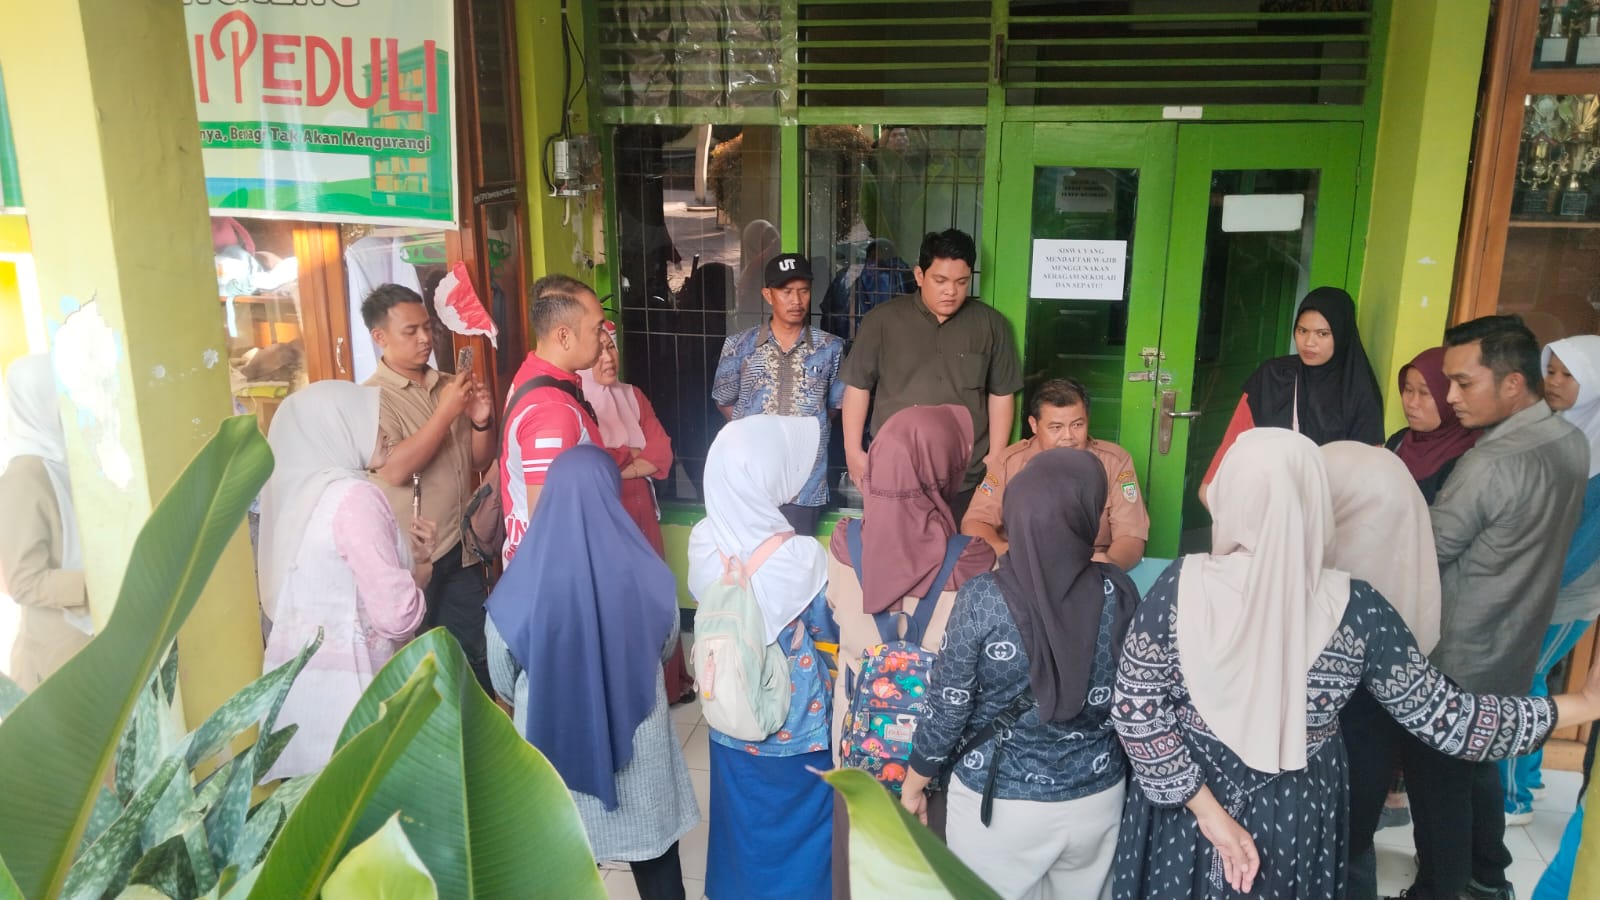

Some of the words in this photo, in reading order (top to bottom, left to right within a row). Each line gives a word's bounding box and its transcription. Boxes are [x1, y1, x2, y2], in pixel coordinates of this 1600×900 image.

[209, 9, 438, 114] PEDULI
[270, 127, 298, 143] Tak
[303, 129, 339, 146] Akan
[342, 130, 431, 152] Mengurangi
[778, 258, 796, 271] UT
